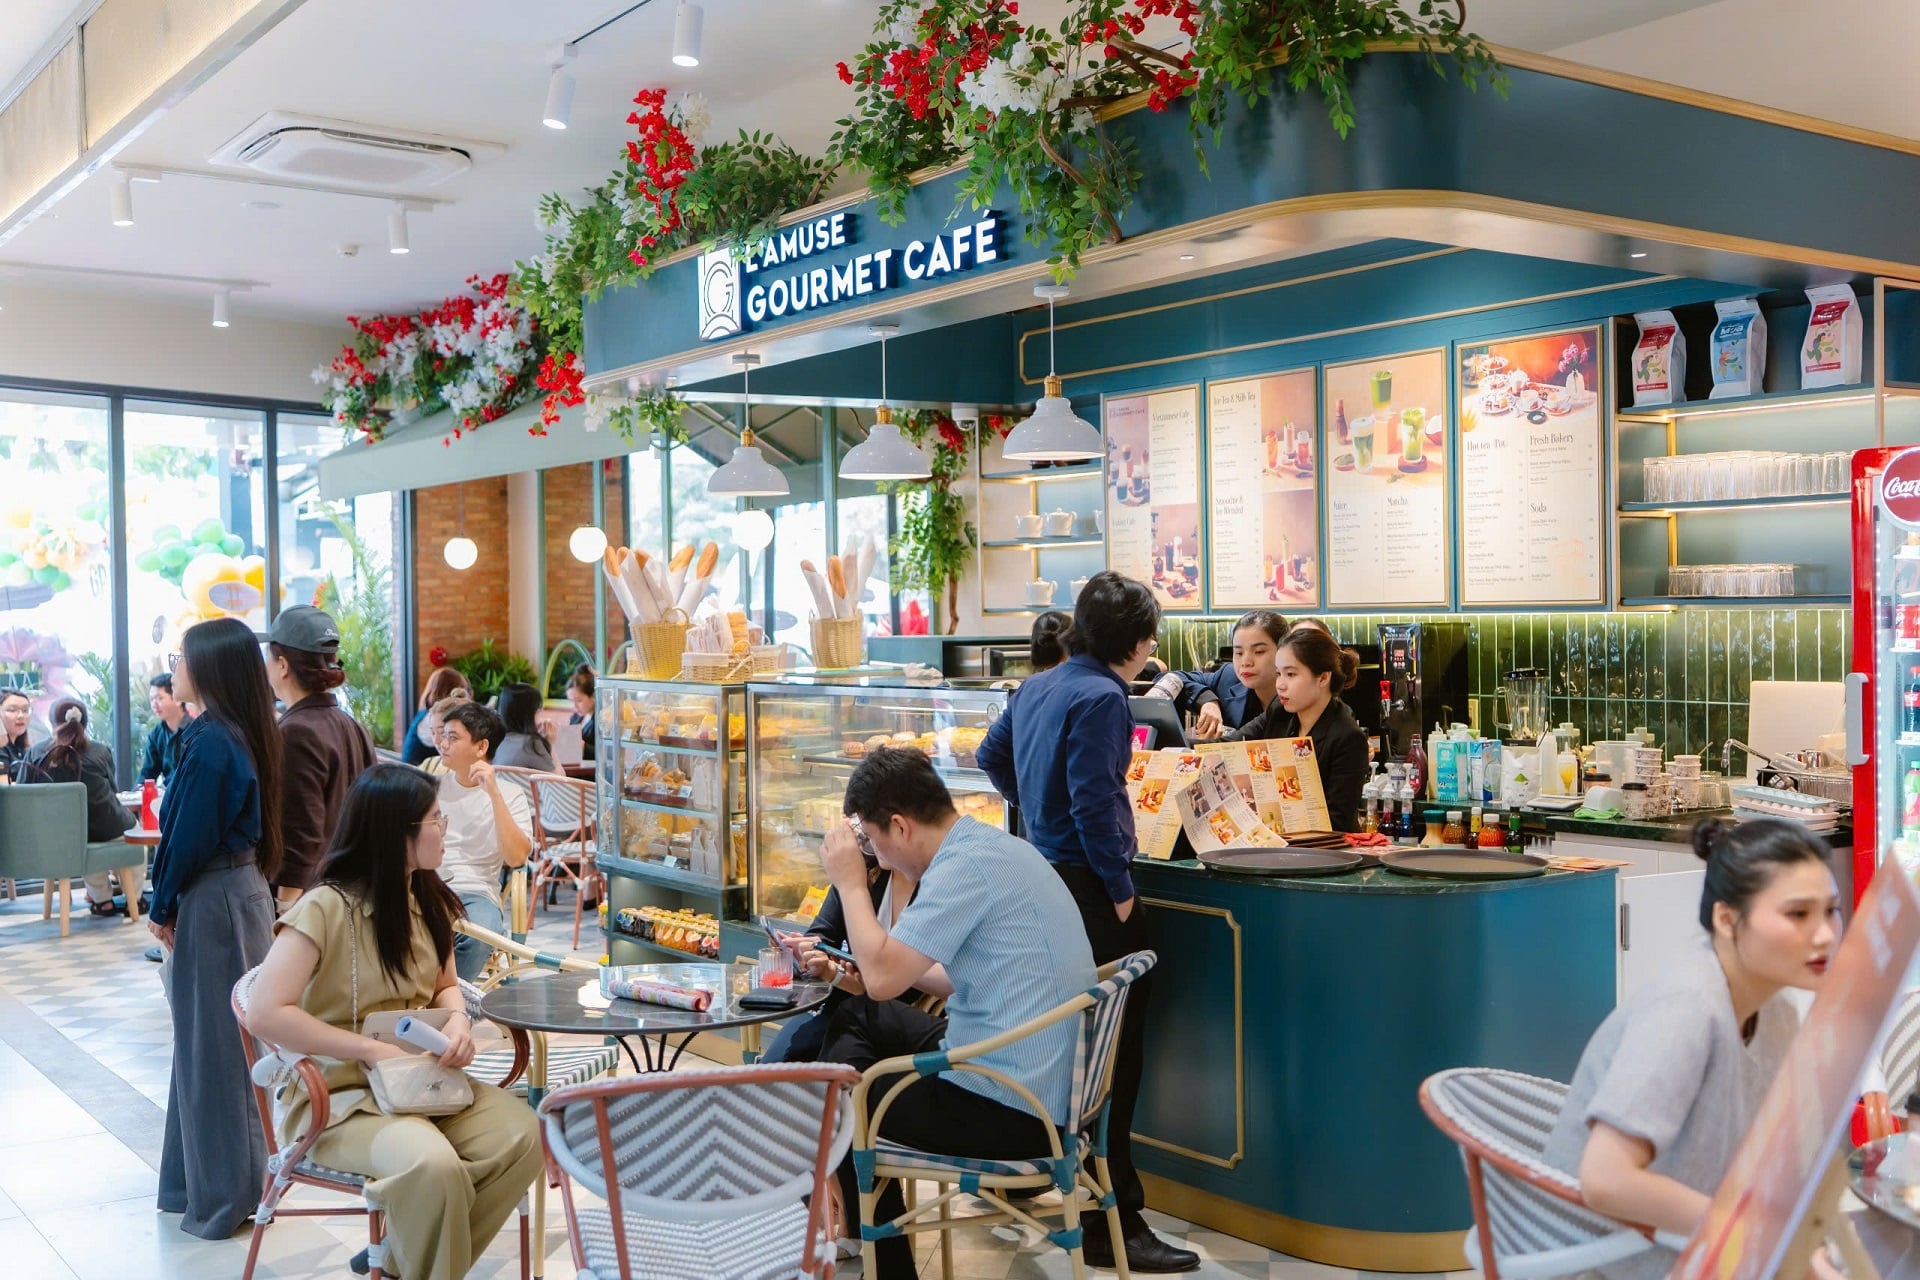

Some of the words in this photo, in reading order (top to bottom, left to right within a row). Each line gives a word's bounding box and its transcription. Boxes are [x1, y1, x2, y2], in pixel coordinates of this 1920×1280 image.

[747, 248, 892, 322] GOURMET
[903, 209, 997, 280] CAFÉ
[1529, 434, 1549, 446] Fresh
[1550, 432, 1574, 444] Bakery
[1530, 502, 1548, 513] Soda
